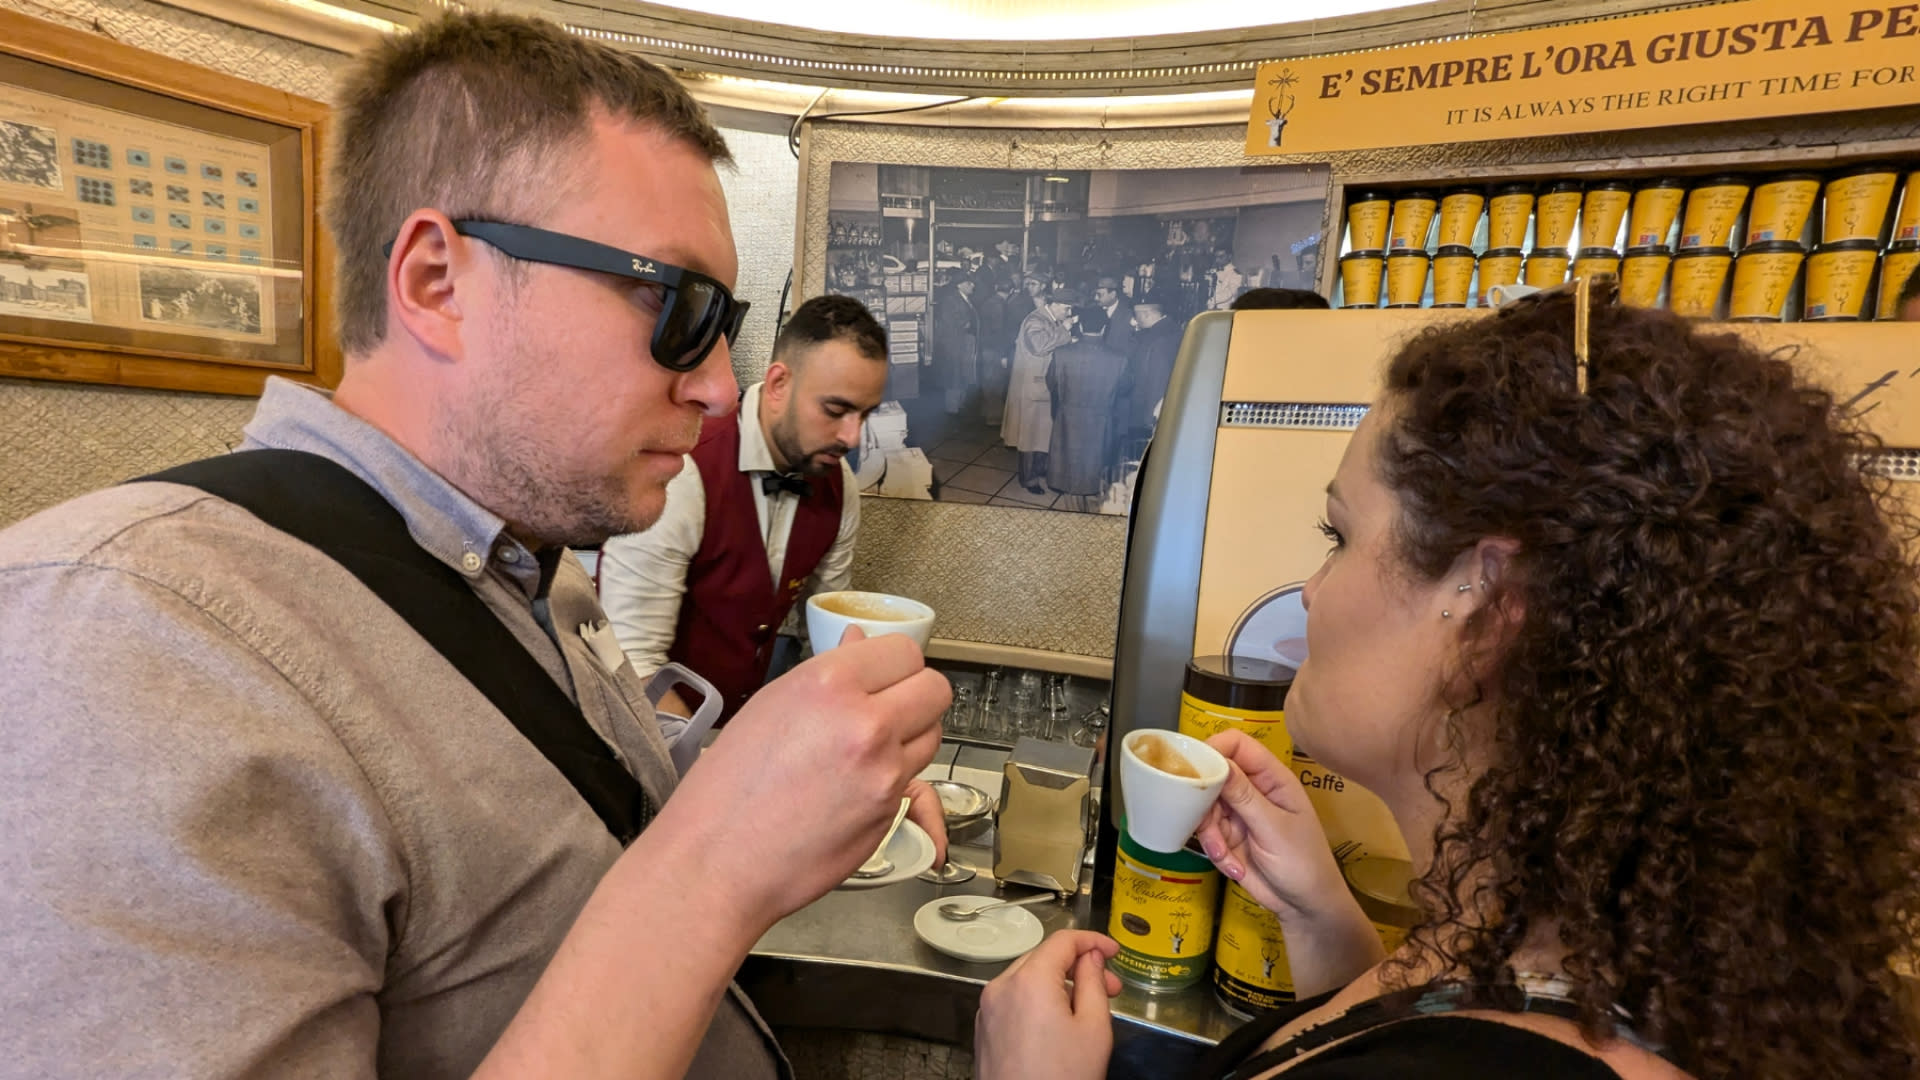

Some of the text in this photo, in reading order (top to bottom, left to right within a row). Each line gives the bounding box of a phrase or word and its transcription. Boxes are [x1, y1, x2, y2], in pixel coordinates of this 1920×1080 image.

[1360, 53, 1513, 96] SEMPRE
[1519, 39, 1637, 80] L’ORA
[1646, 15, 1833, 64] GIUSTA
[1843, 3, 1920, 43] PE
[1446, 65, 1915, 125] IT IS ALWAYS THE RIGHT TIME FOR
[1299, 769, 1345, 793] Caffè
